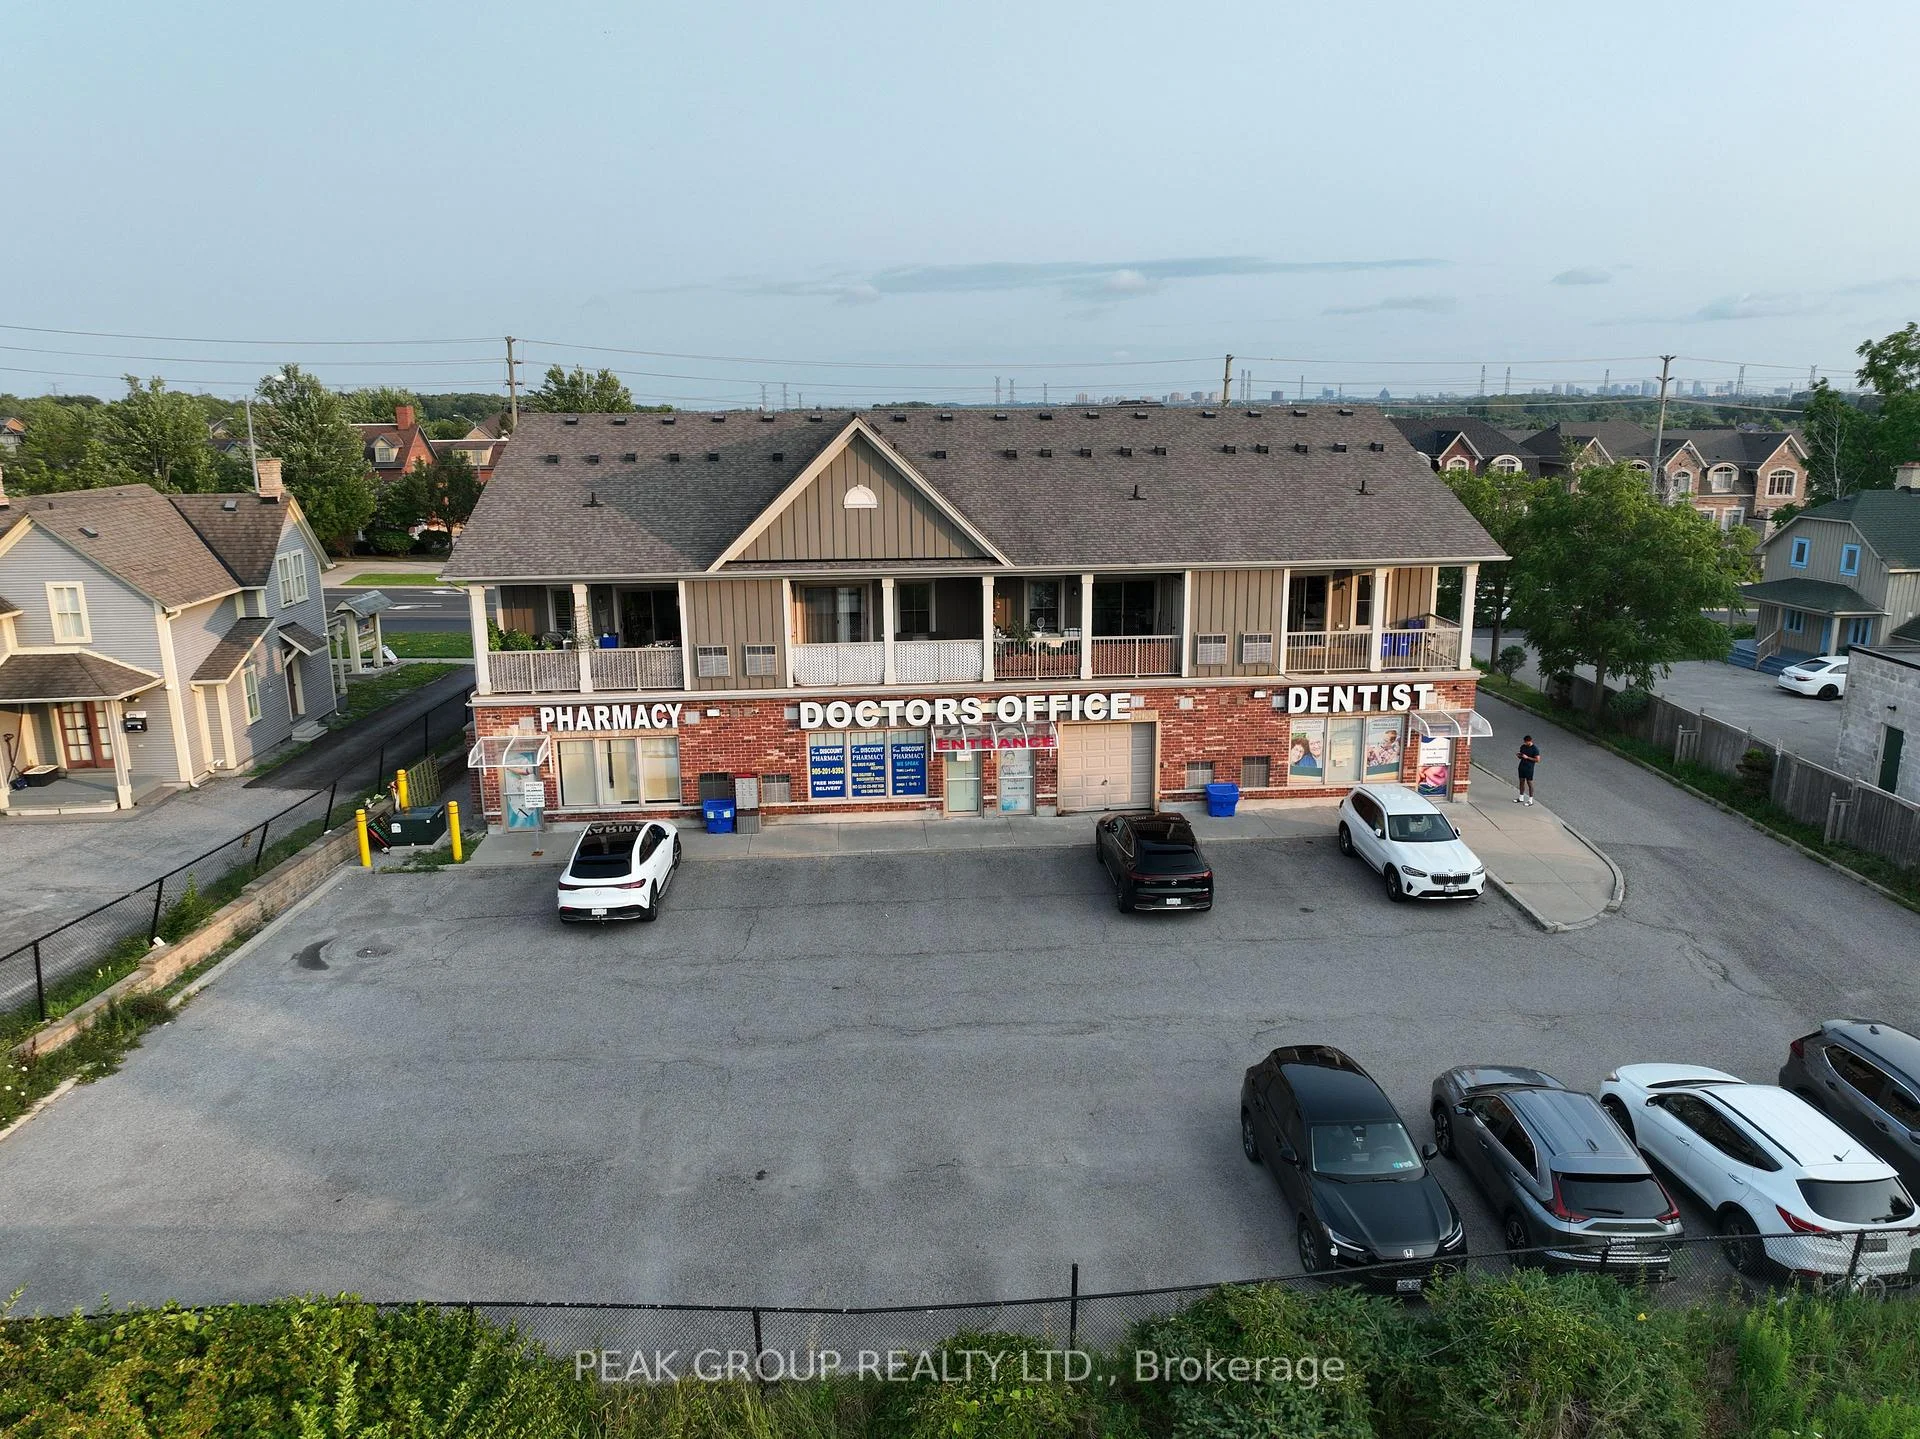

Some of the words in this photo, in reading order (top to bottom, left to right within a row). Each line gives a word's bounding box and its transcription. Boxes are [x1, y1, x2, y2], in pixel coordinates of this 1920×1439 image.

[800, 697, 982, 729] DOCTORS
[997, 693, 1132, 723] OFFICE
[1288, 684, 1434, 714] DENTIST
[540, 703, 682, 732] PHARMACY
[937, 737, 1055, 750] ENTRANCE
